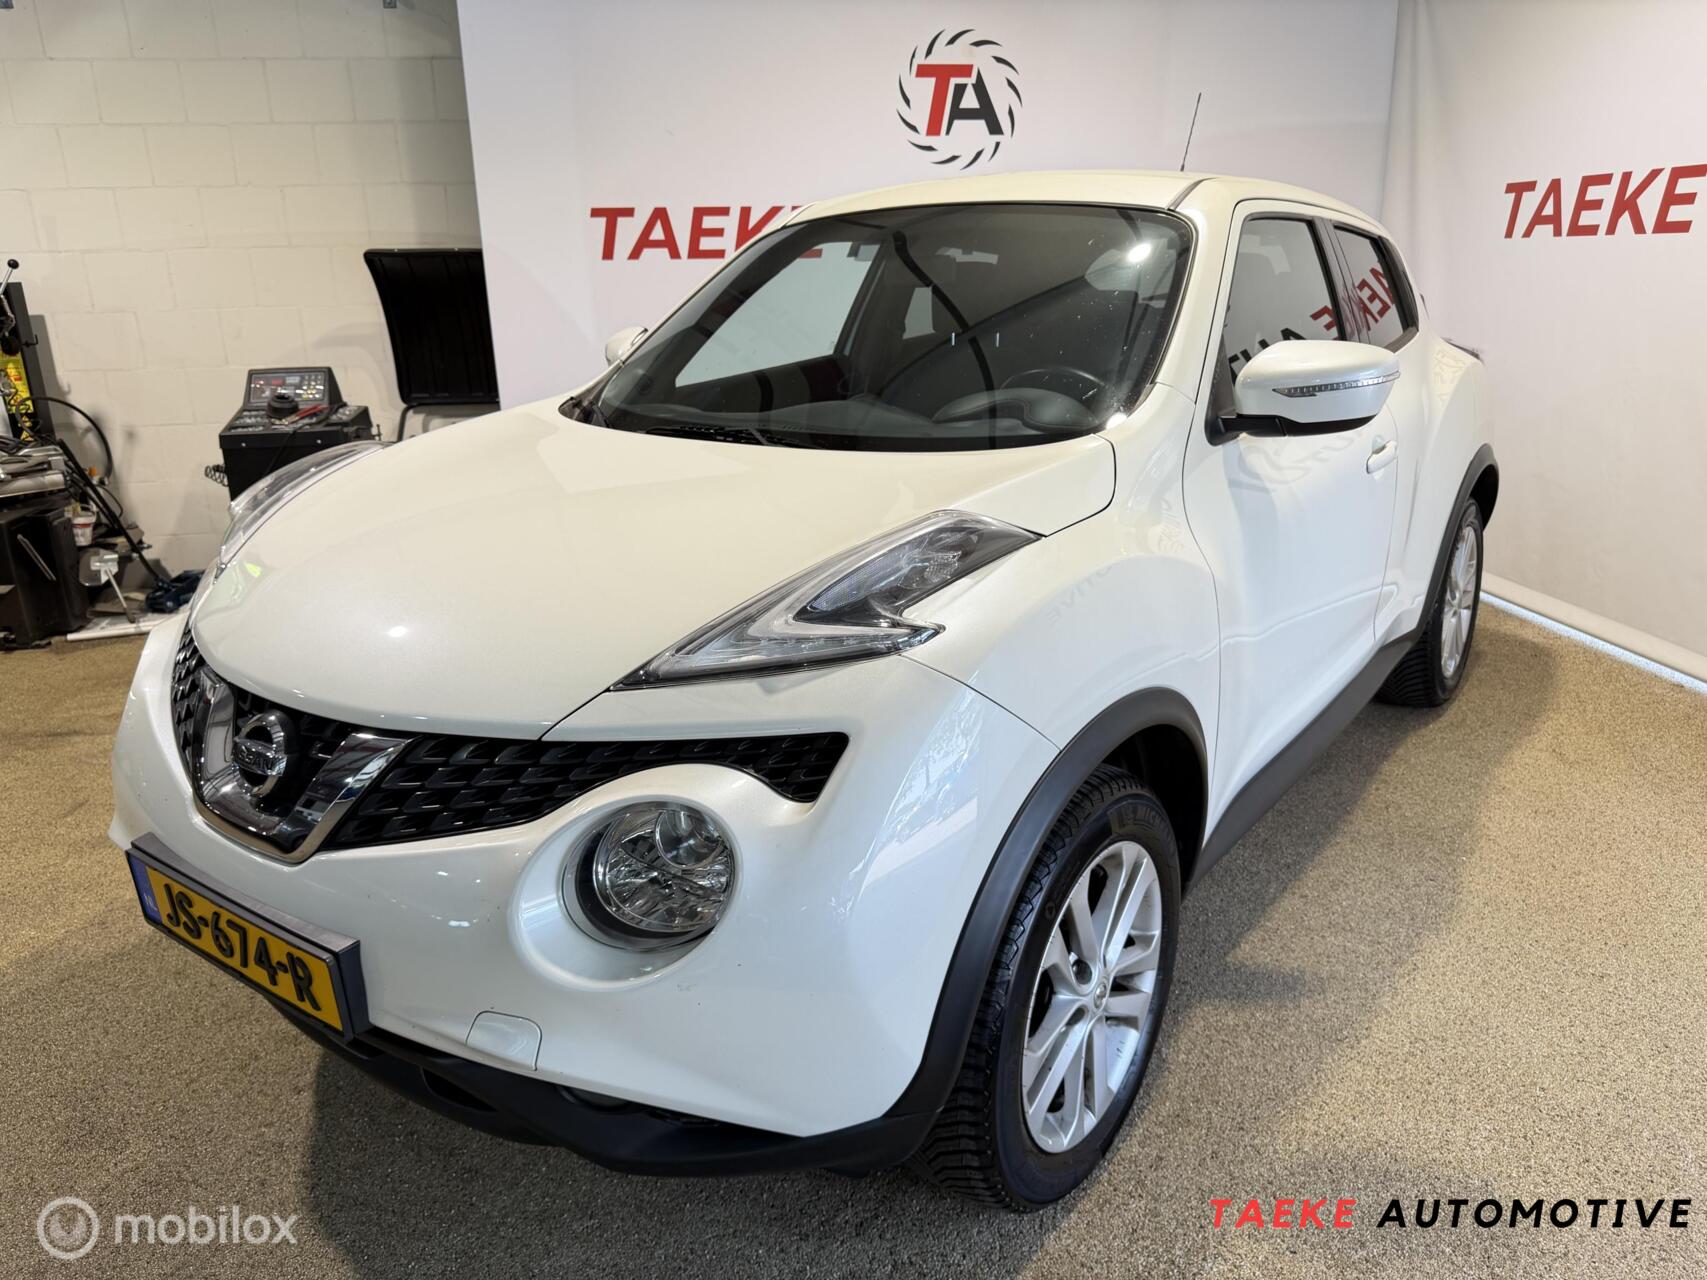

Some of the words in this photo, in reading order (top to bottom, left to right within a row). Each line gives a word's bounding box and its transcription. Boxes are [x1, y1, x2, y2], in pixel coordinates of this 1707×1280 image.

[915, 64, 1004, 136] TA
[590, 206, 823, 260] TAEK
[1504, 164, 1707, 239] TAEKE
[164, 883, 321, 1011] JS-674-R
